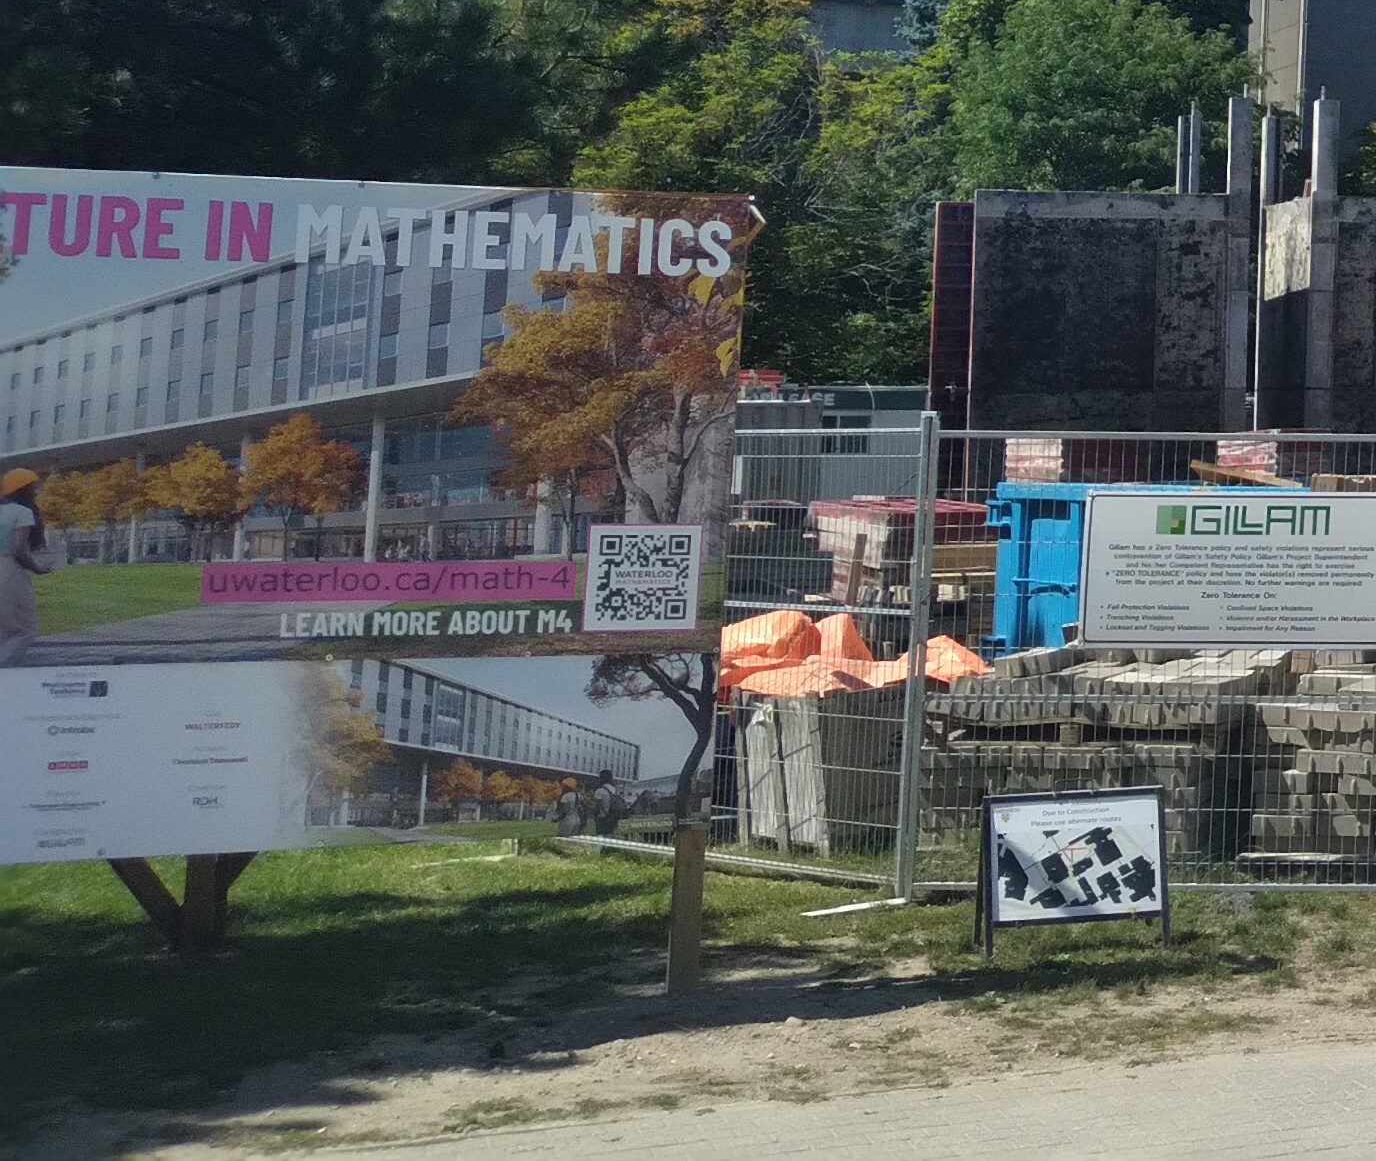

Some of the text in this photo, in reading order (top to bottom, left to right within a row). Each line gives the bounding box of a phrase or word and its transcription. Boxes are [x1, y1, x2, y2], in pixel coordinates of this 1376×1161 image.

[0, 192, 731, 278] TURE IN MATHEMATICS
[1191, 505, 1330, 535] GILLAM
[208, 566, 571, 595] uwaterloo.ca/math-4
[615, 570, 673, 578] WATERLOO
[279, 609, 573, 638] LEARN MORE ABOUT M4
[631, 820, 673, 828] WATERLOO
[1066, 807, 1109, 815] Construction
